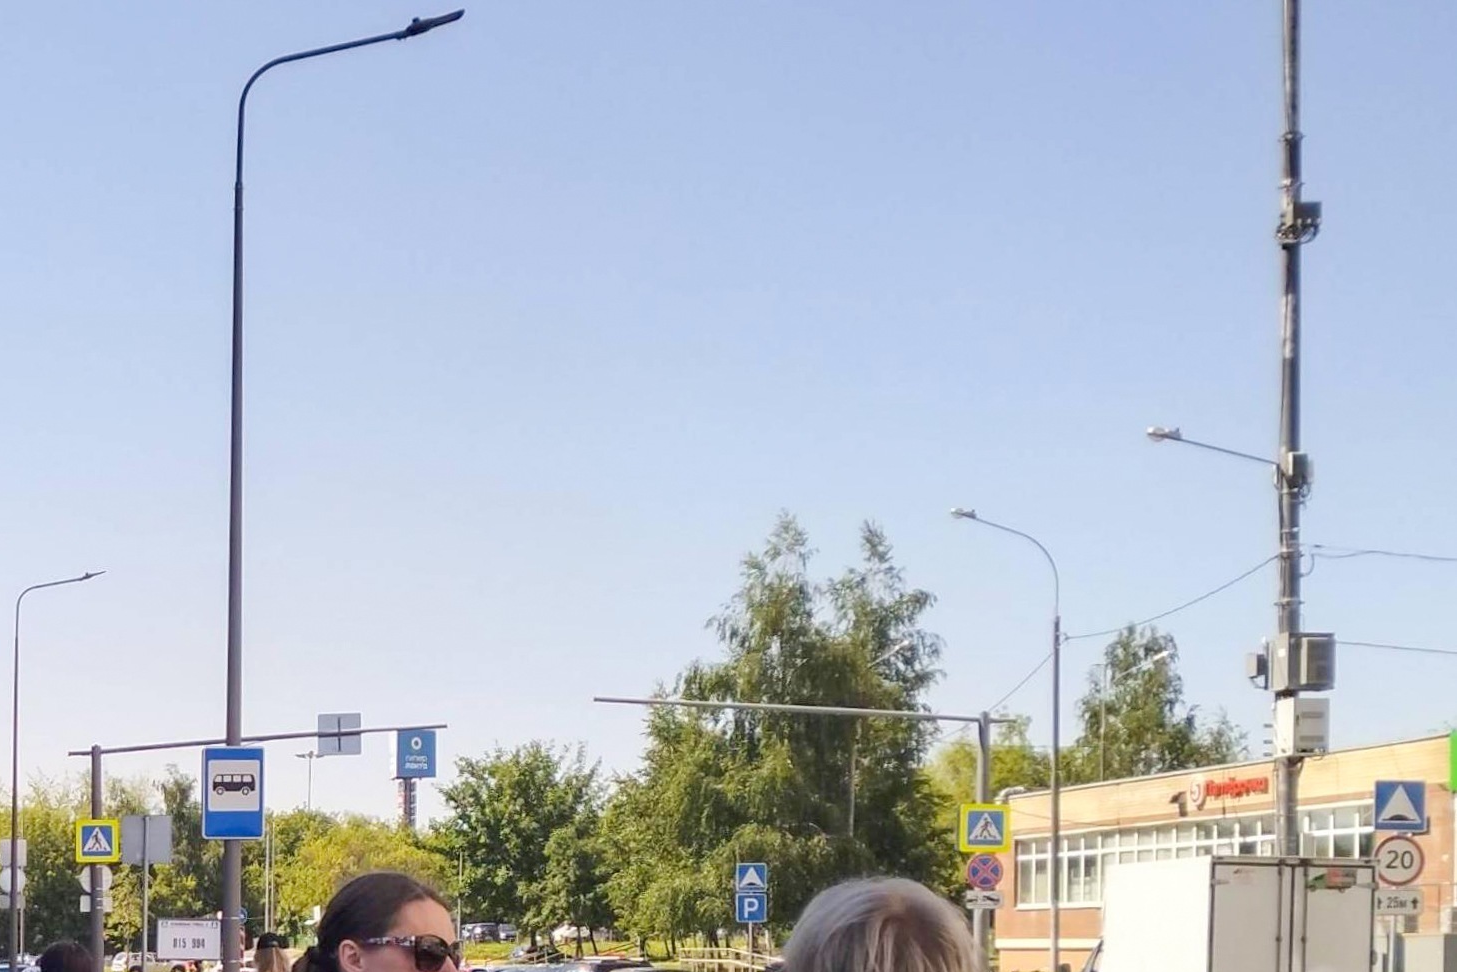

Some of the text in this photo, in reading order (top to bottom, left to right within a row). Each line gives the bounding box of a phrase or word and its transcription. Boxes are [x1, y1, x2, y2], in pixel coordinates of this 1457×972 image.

[1386, 850, 1414, 869] 20
[744, 898, 759, 918] P
[1386, 896, 1407, 909] 25м
